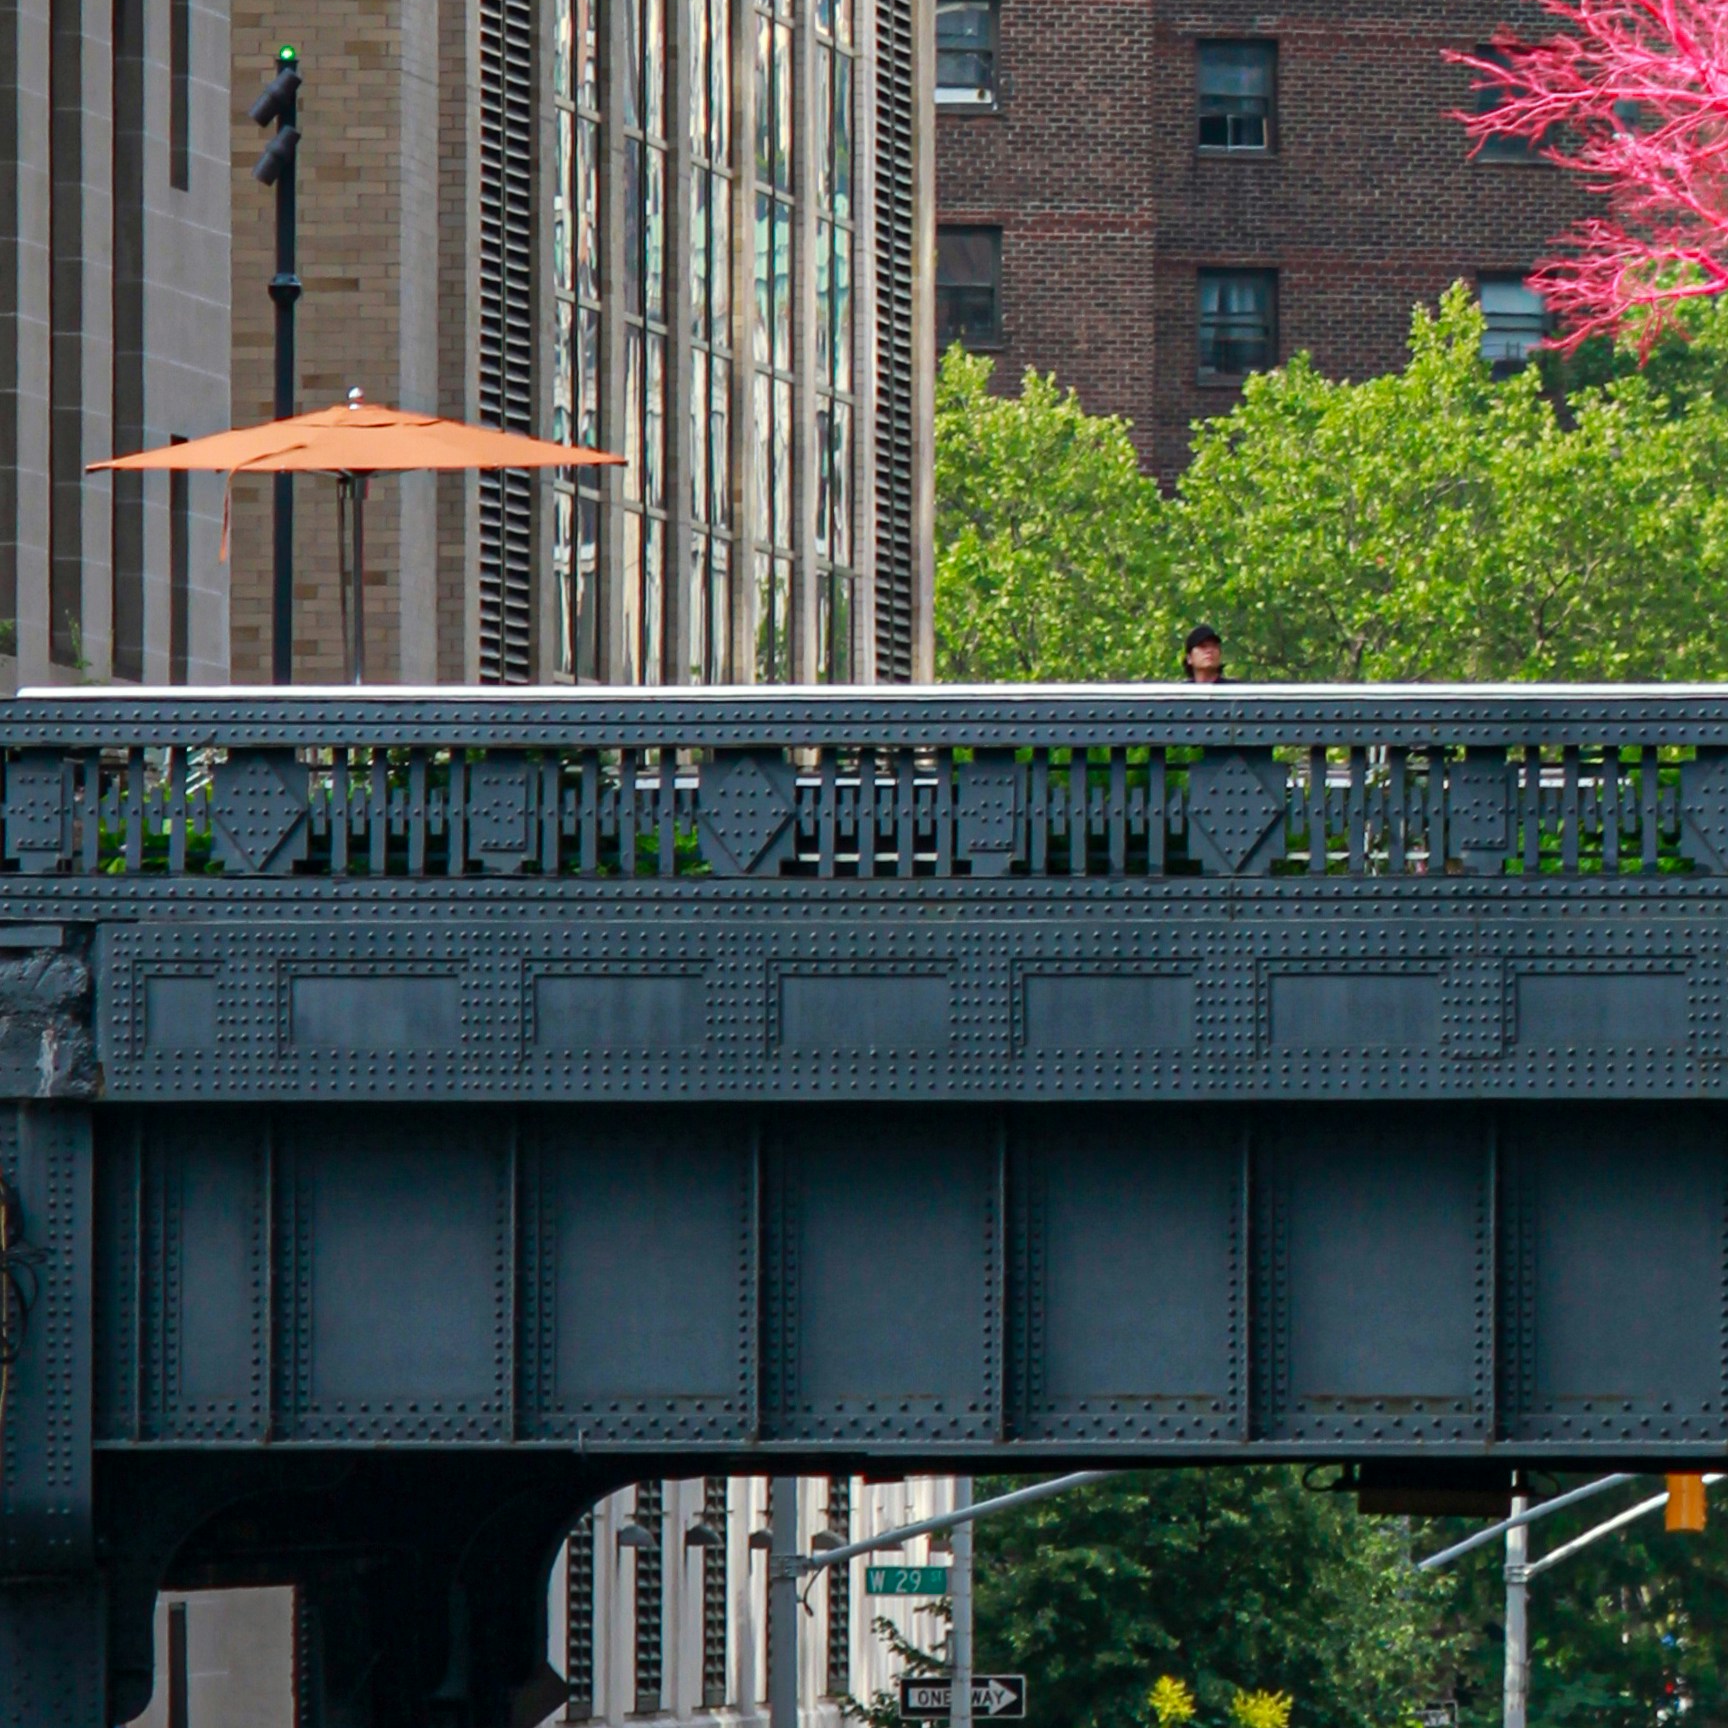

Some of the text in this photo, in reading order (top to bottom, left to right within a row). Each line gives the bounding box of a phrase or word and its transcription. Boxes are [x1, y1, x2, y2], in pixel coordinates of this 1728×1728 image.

[870, 1570, 884, 1592] W
[895, 1570, 921, 1592] 29
[917, 1690, 950, 1705] ONE
